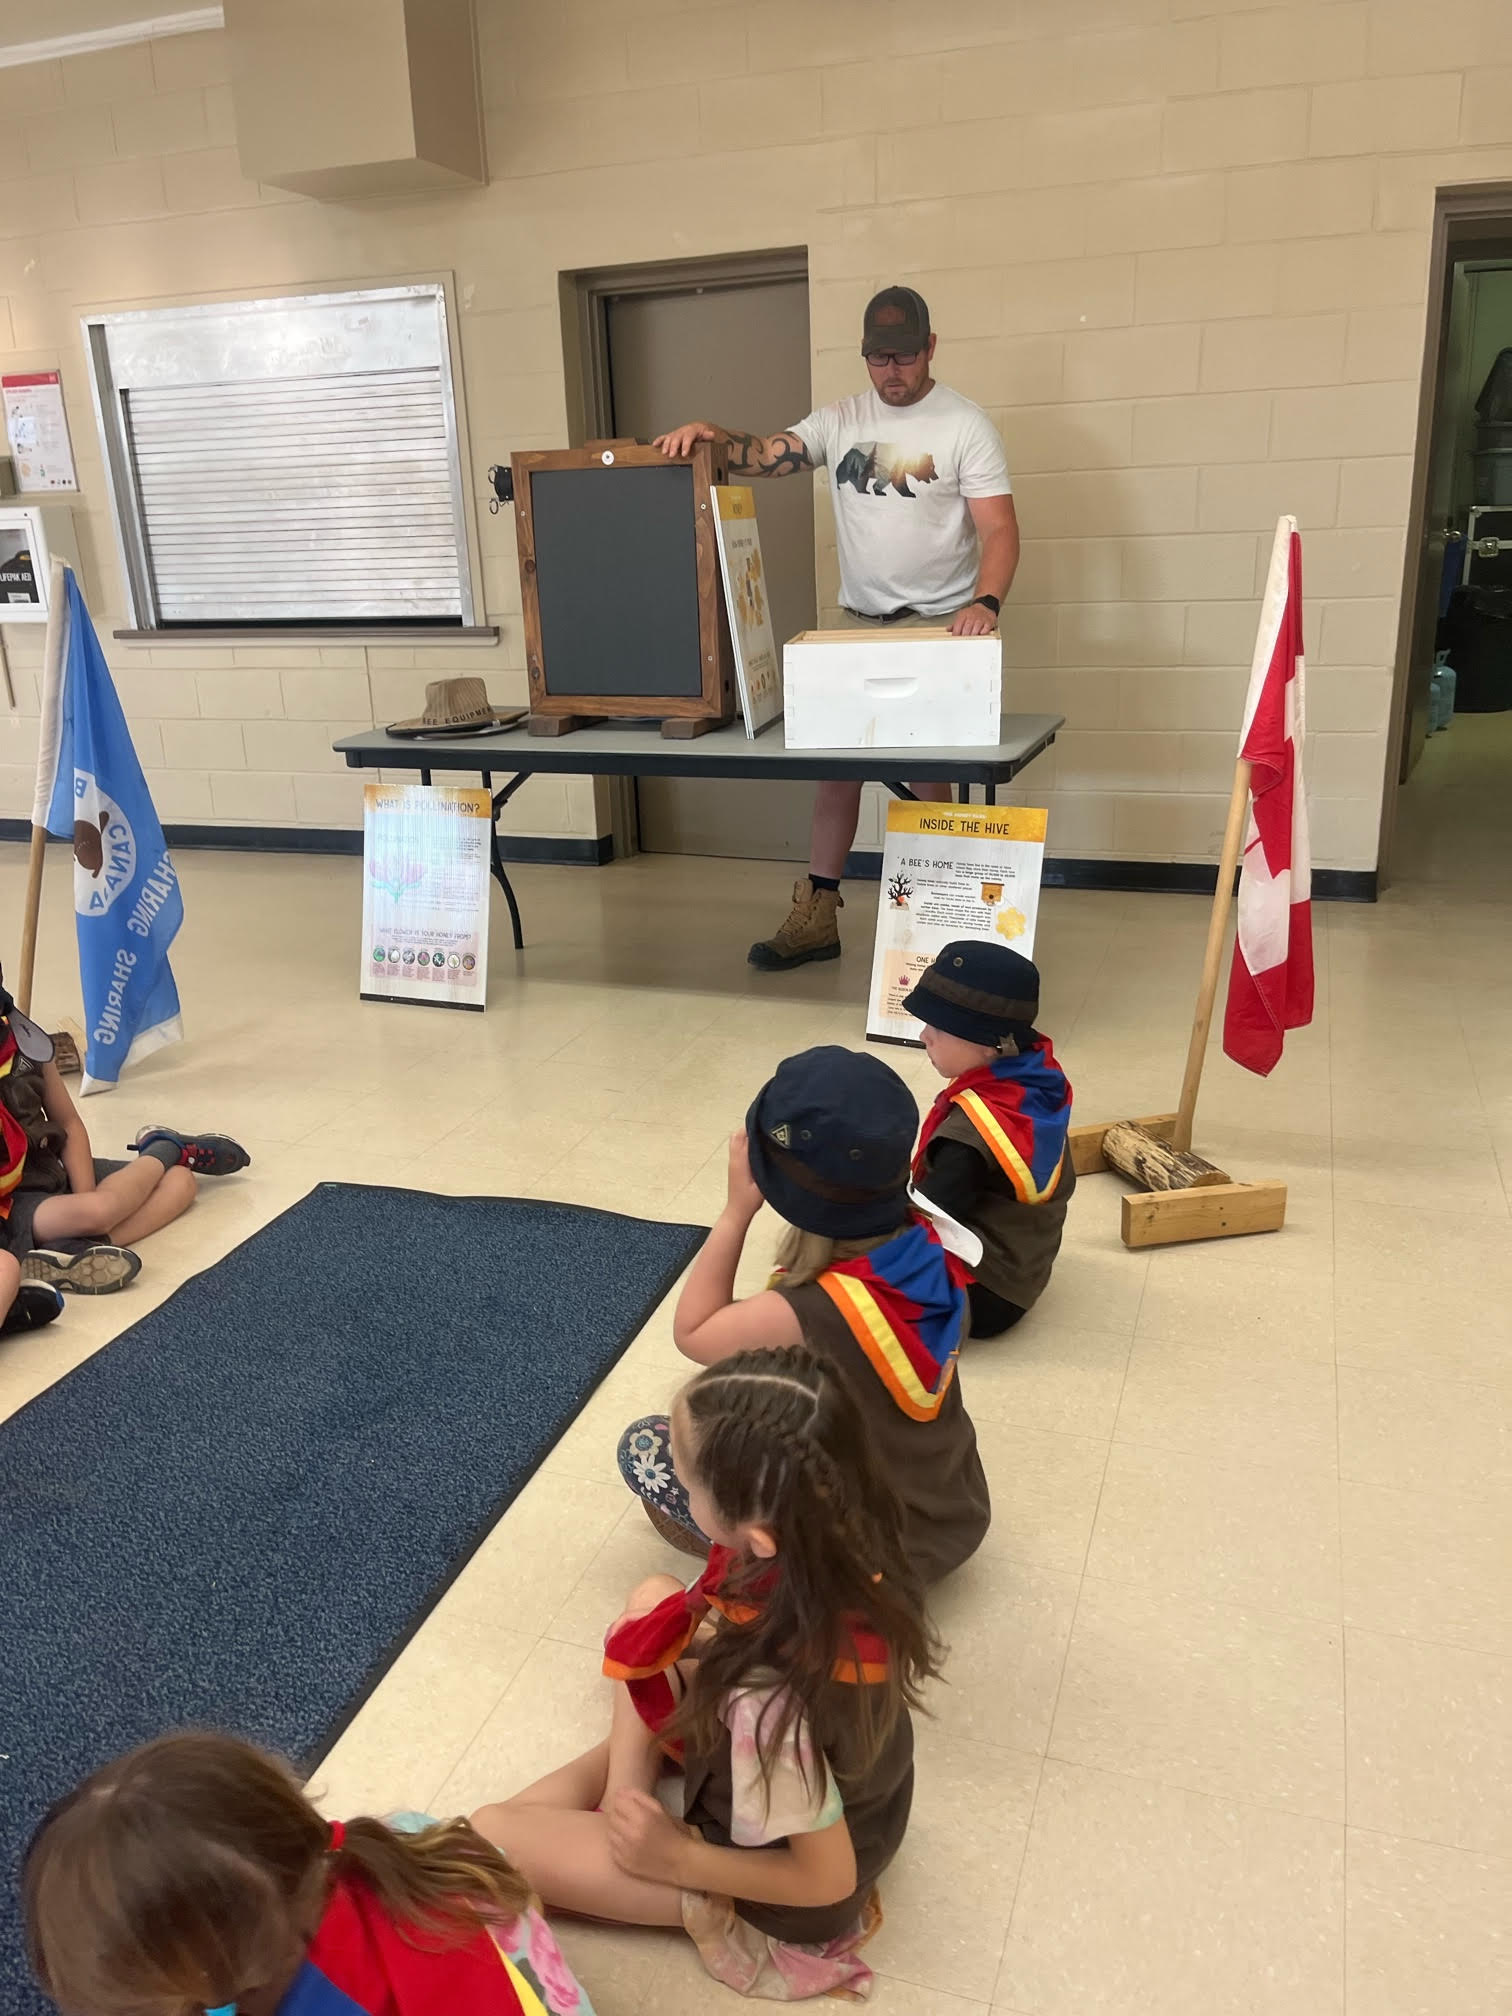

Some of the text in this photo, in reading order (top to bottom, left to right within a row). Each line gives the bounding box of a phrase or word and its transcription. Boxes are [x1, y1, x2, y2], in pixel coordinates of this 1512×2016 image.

[375, 799, 398, 809] WHAT
[403, 800, 411, 809] IS
[919, 818, 1010, 835] INSIDE THE HIVE
[900, 858, 906, 866] A
[908, 858, 930, 868] BEE'S
[932, 860, 954, 870] HOME
[421, 929, 435, 937] YOUR
[916, 956, 929, 964] ONE
